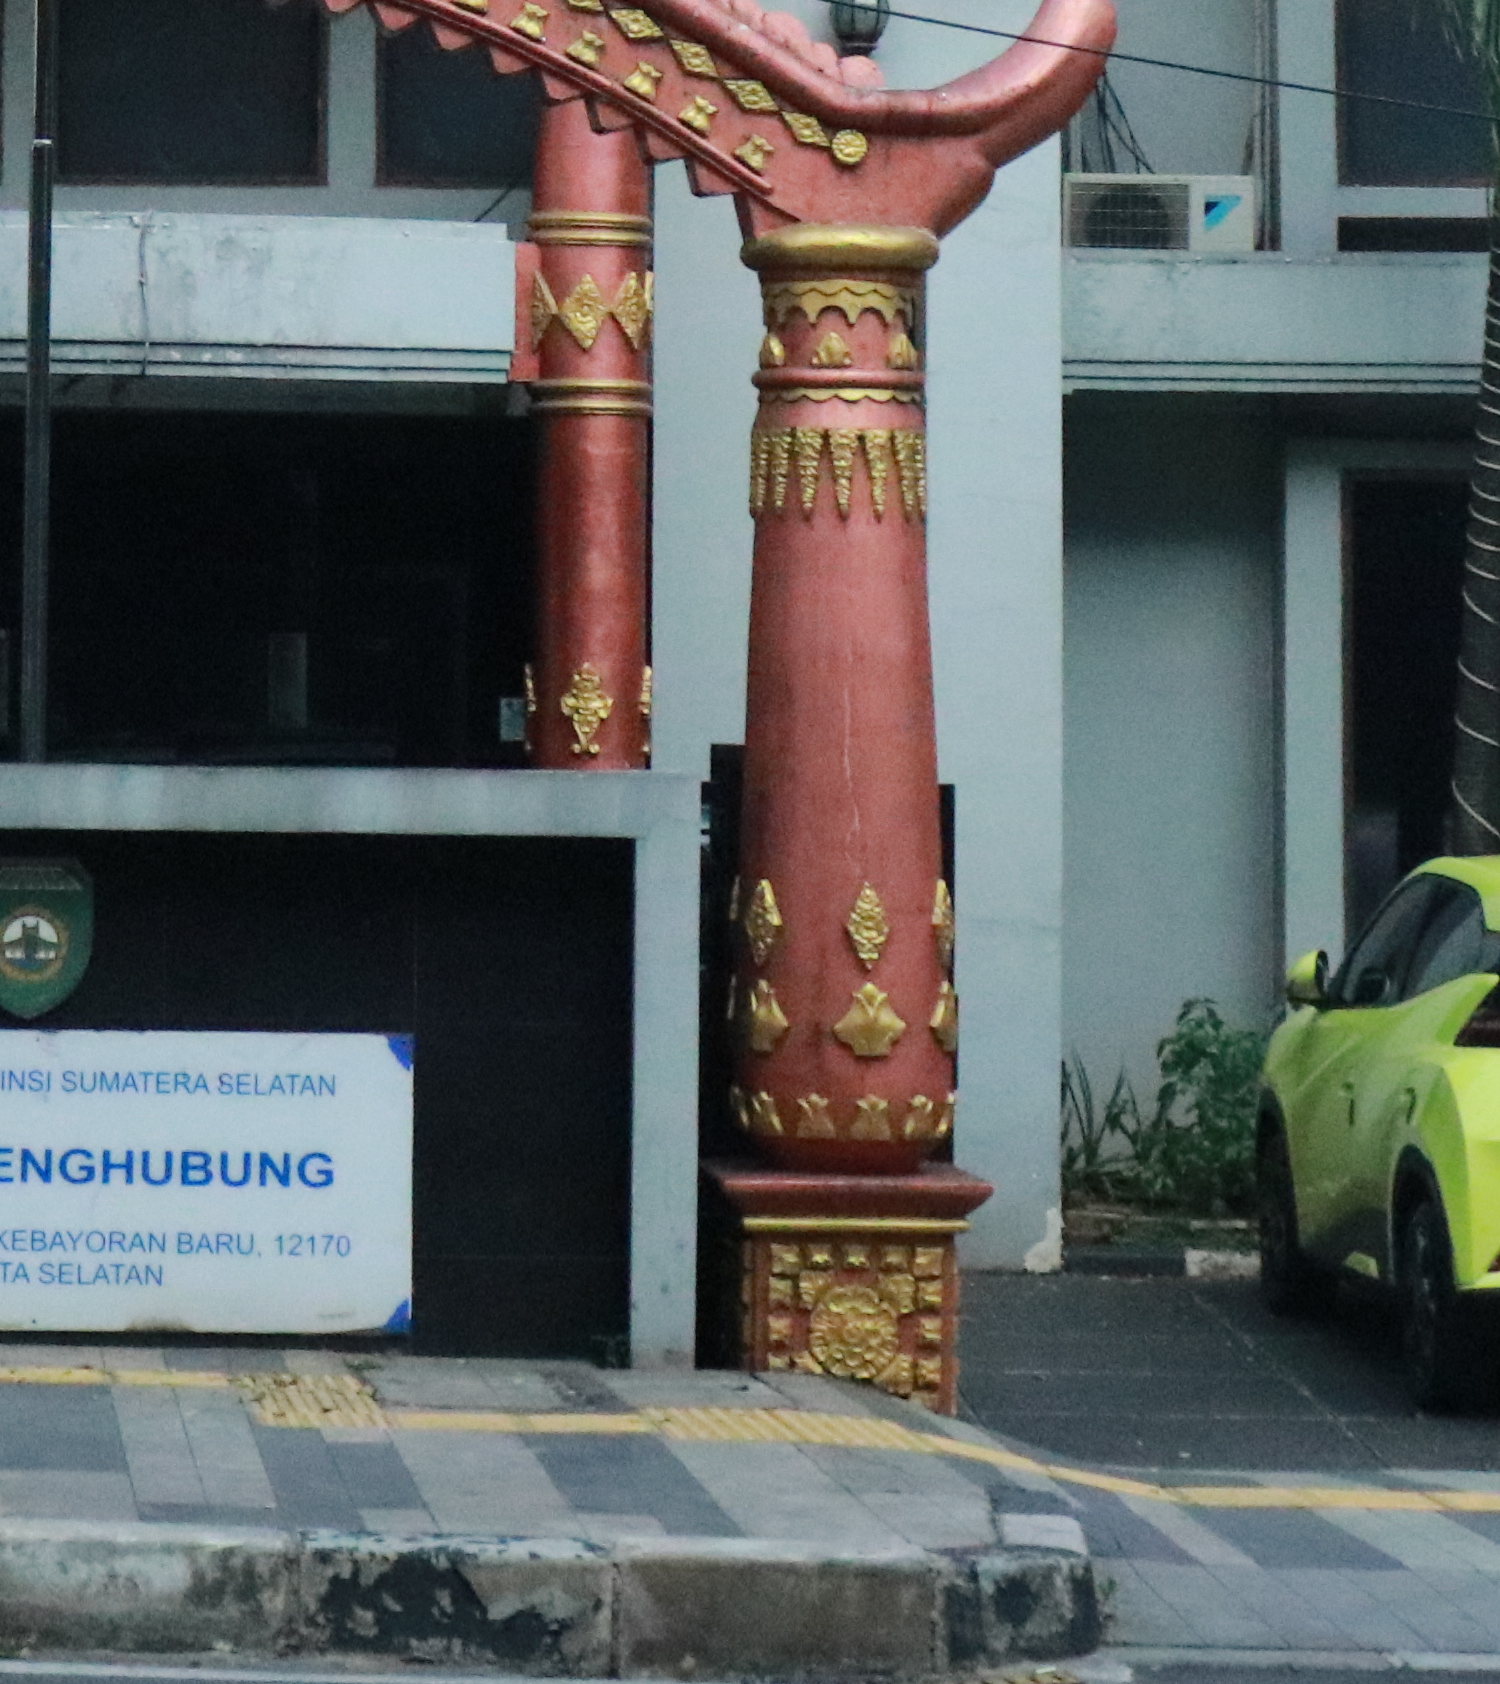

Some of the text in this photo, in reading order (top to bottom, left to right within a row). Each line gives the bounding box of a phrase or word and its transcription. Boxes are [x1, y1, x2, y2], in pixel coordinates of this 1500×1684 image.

[61, 1070, 210, 1095] SUMATERA
[217, 1073, 337, 1097] SELATAN
[176, 1231, 262, 1258] BARU,
[274, 1234, 350, 1258] 12170
[38, 1263, 164, 1287] SELATAN
